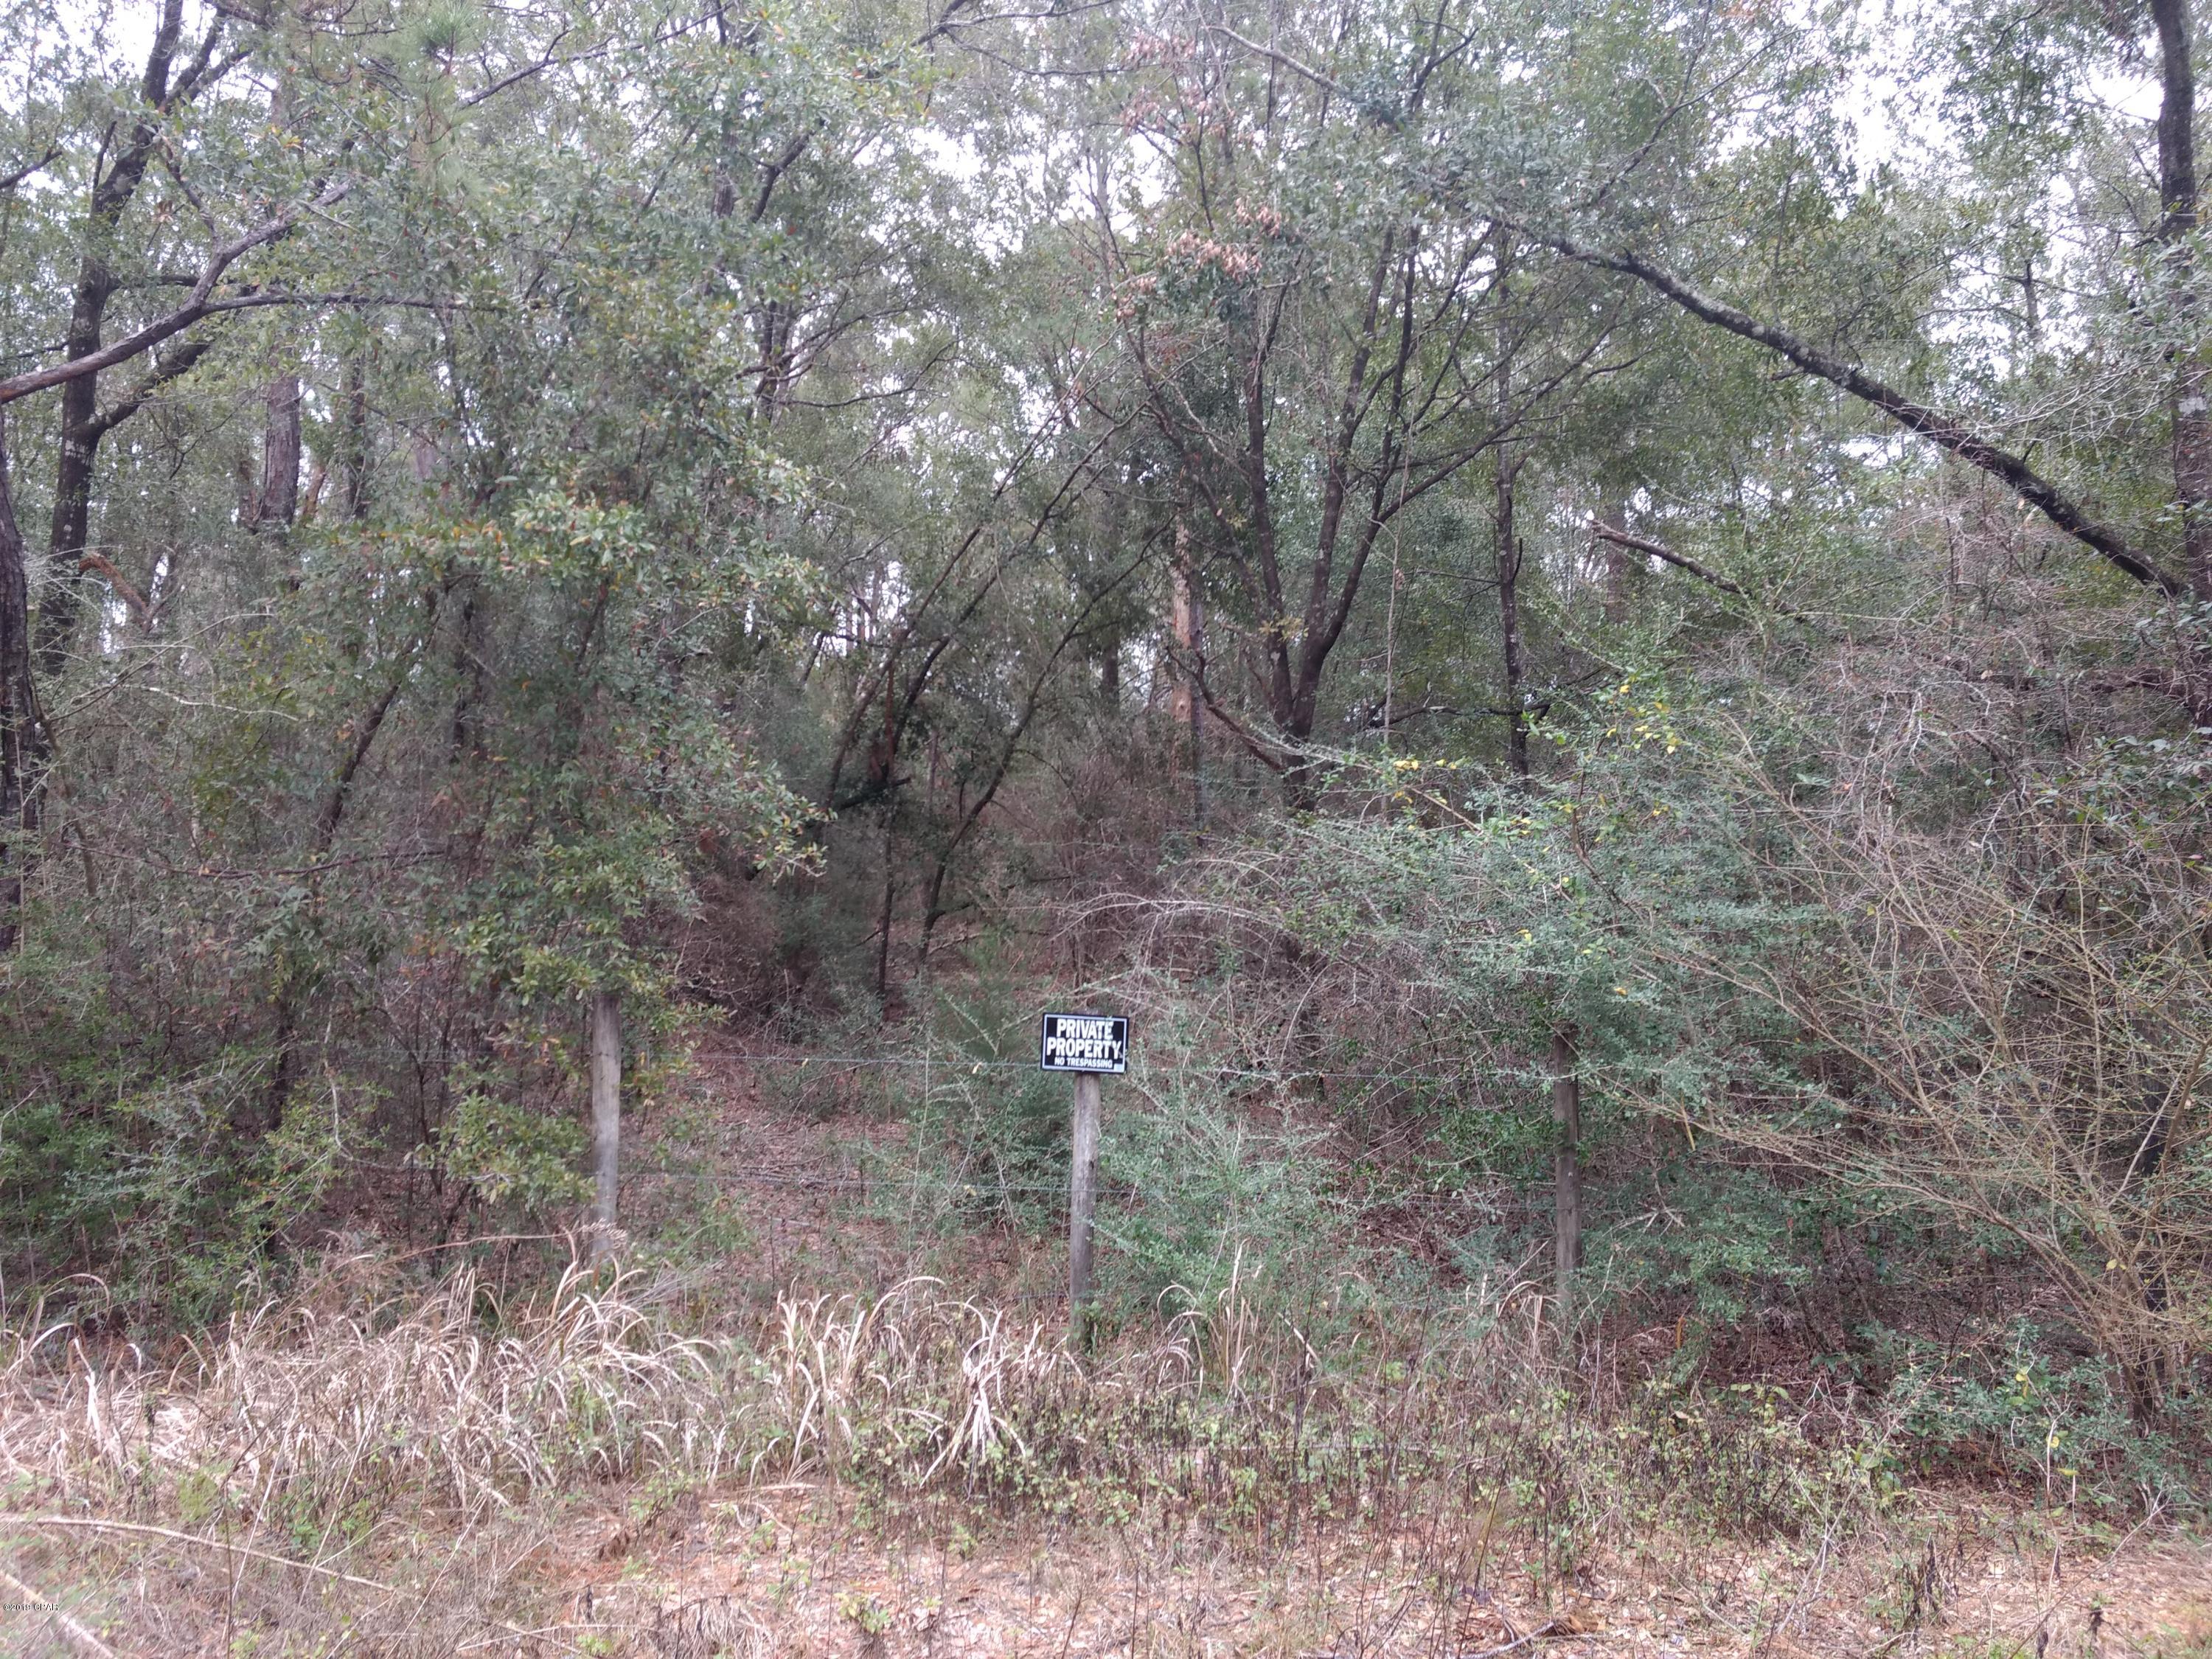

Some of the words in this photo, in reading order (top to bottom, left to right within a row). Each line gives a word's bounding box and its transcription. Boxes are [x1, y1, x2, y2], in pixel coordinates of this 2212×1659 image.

[1057, 1018, 1114, 1040] PRIVATE
[1046, 1037, 1121, 1060] PROPERTY
[1054, 1057, 1065, 1065] NO
[1067, 1057, 1113, 1068] TRESPASSING
